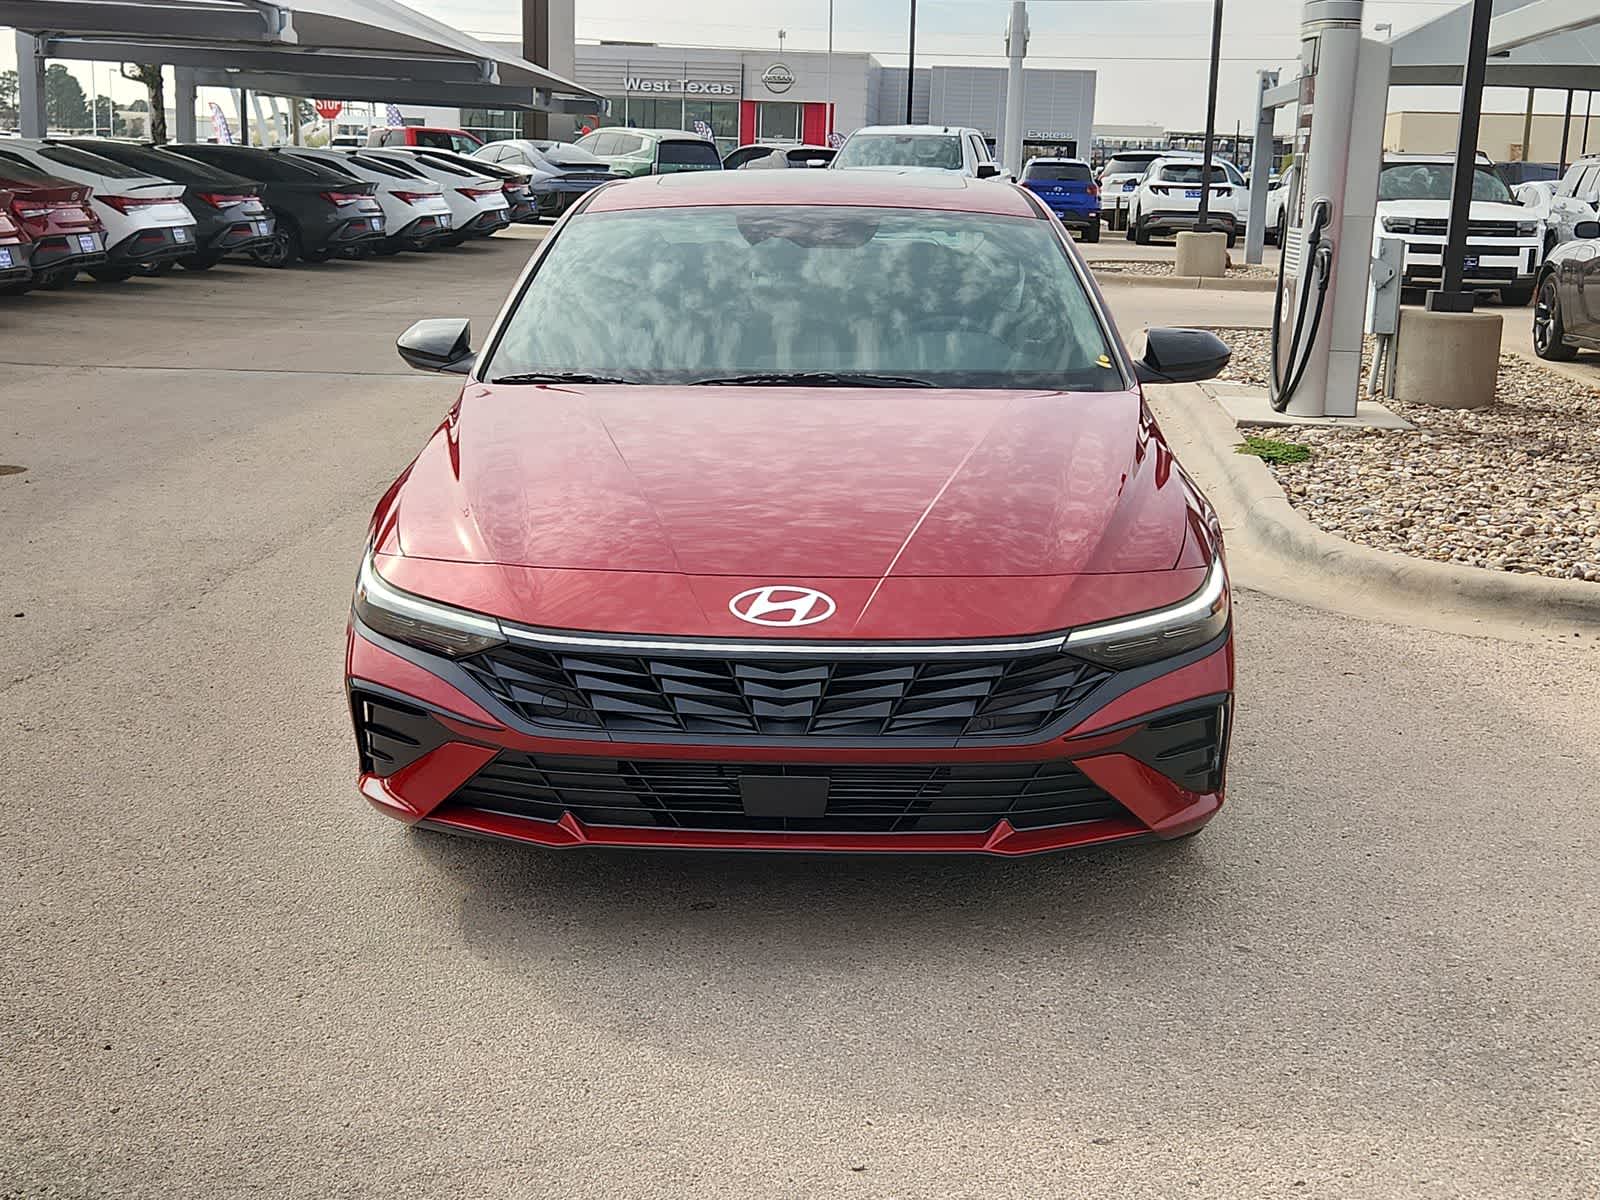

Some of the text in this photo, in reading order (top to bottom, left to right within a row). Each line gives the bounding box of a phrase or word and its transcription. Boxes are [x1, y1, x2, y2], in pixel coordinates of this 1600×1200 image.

[623, 78, 735, 94] West Texas
[316, 99, 341, 110] STOP
[1027, 129, 1073, 140] Express
